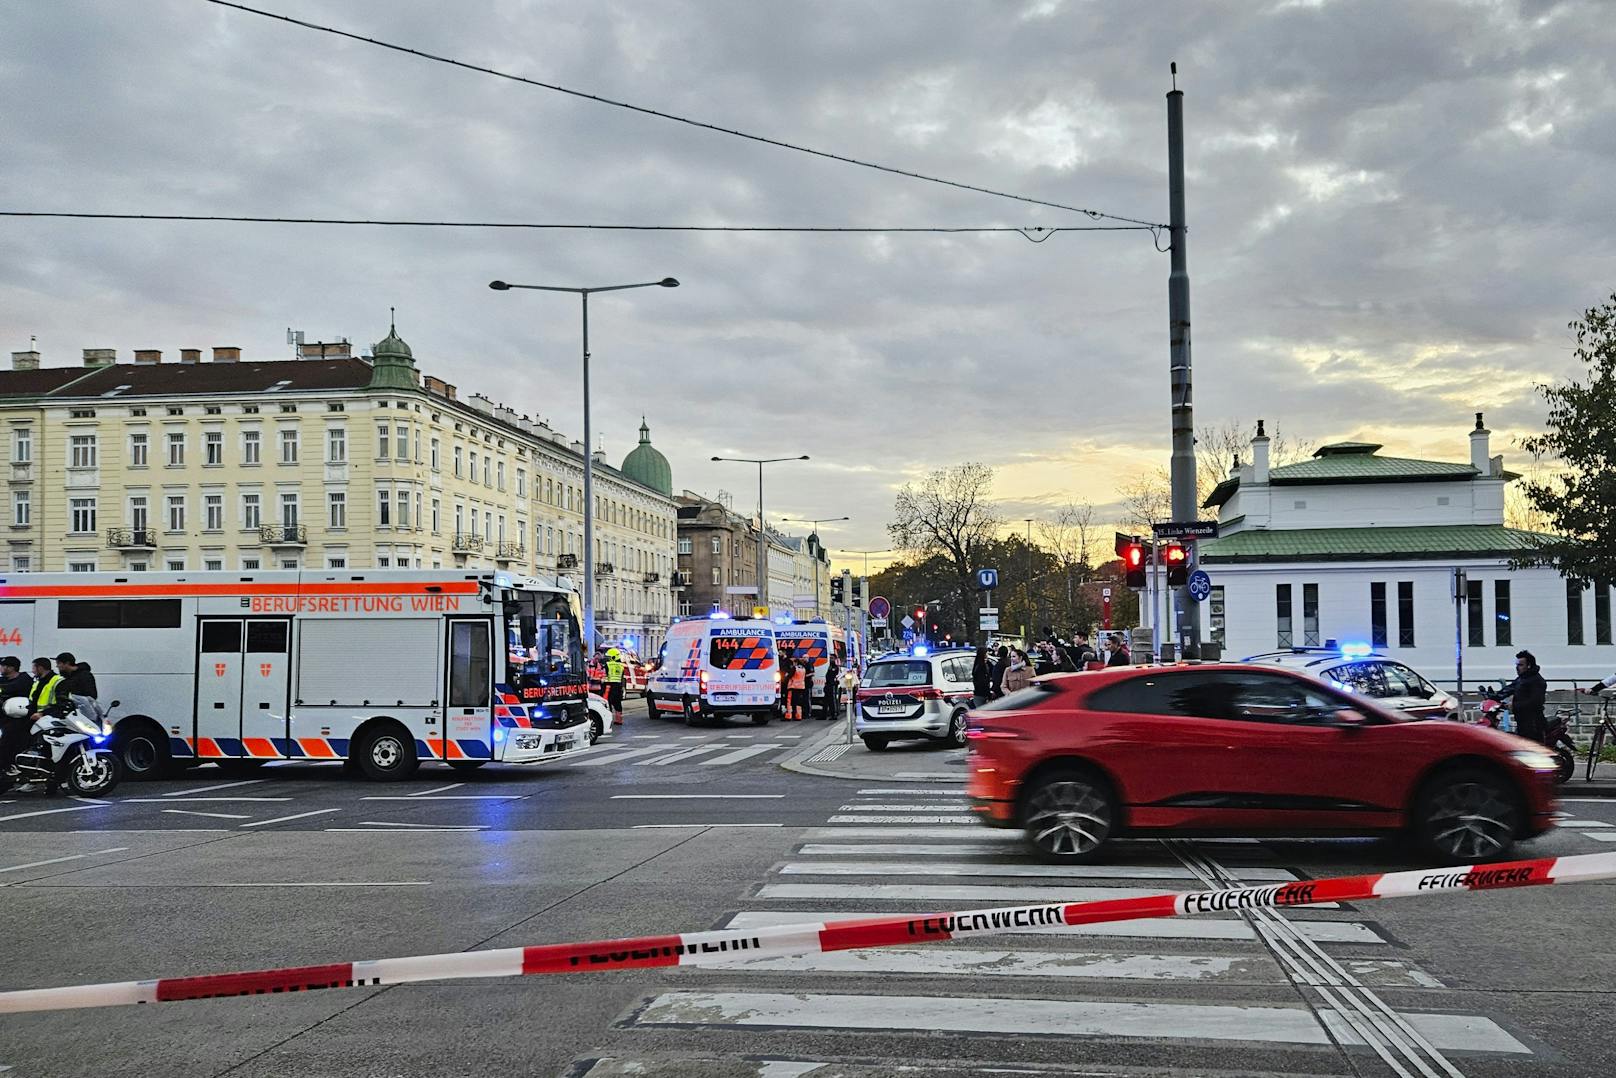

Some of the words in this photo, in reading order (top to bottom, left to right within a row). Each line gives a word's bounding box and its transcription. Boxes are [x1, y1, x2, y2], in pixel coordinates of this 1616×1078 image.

[1184, 526, 1213, 534] Wienzeile
[981, 573, 993, 586] U
[252, 597, 402, 613] BERUFSRETTUNG
[411, 597, 459, 611] WIEN
[716, 639, 739, 649] 144
[777, 640, 796, 649] 144
[524, 685, 577, 698] BERUFSRETTUNG
[1184, 885, 1317, 913] FEUERWEHR
